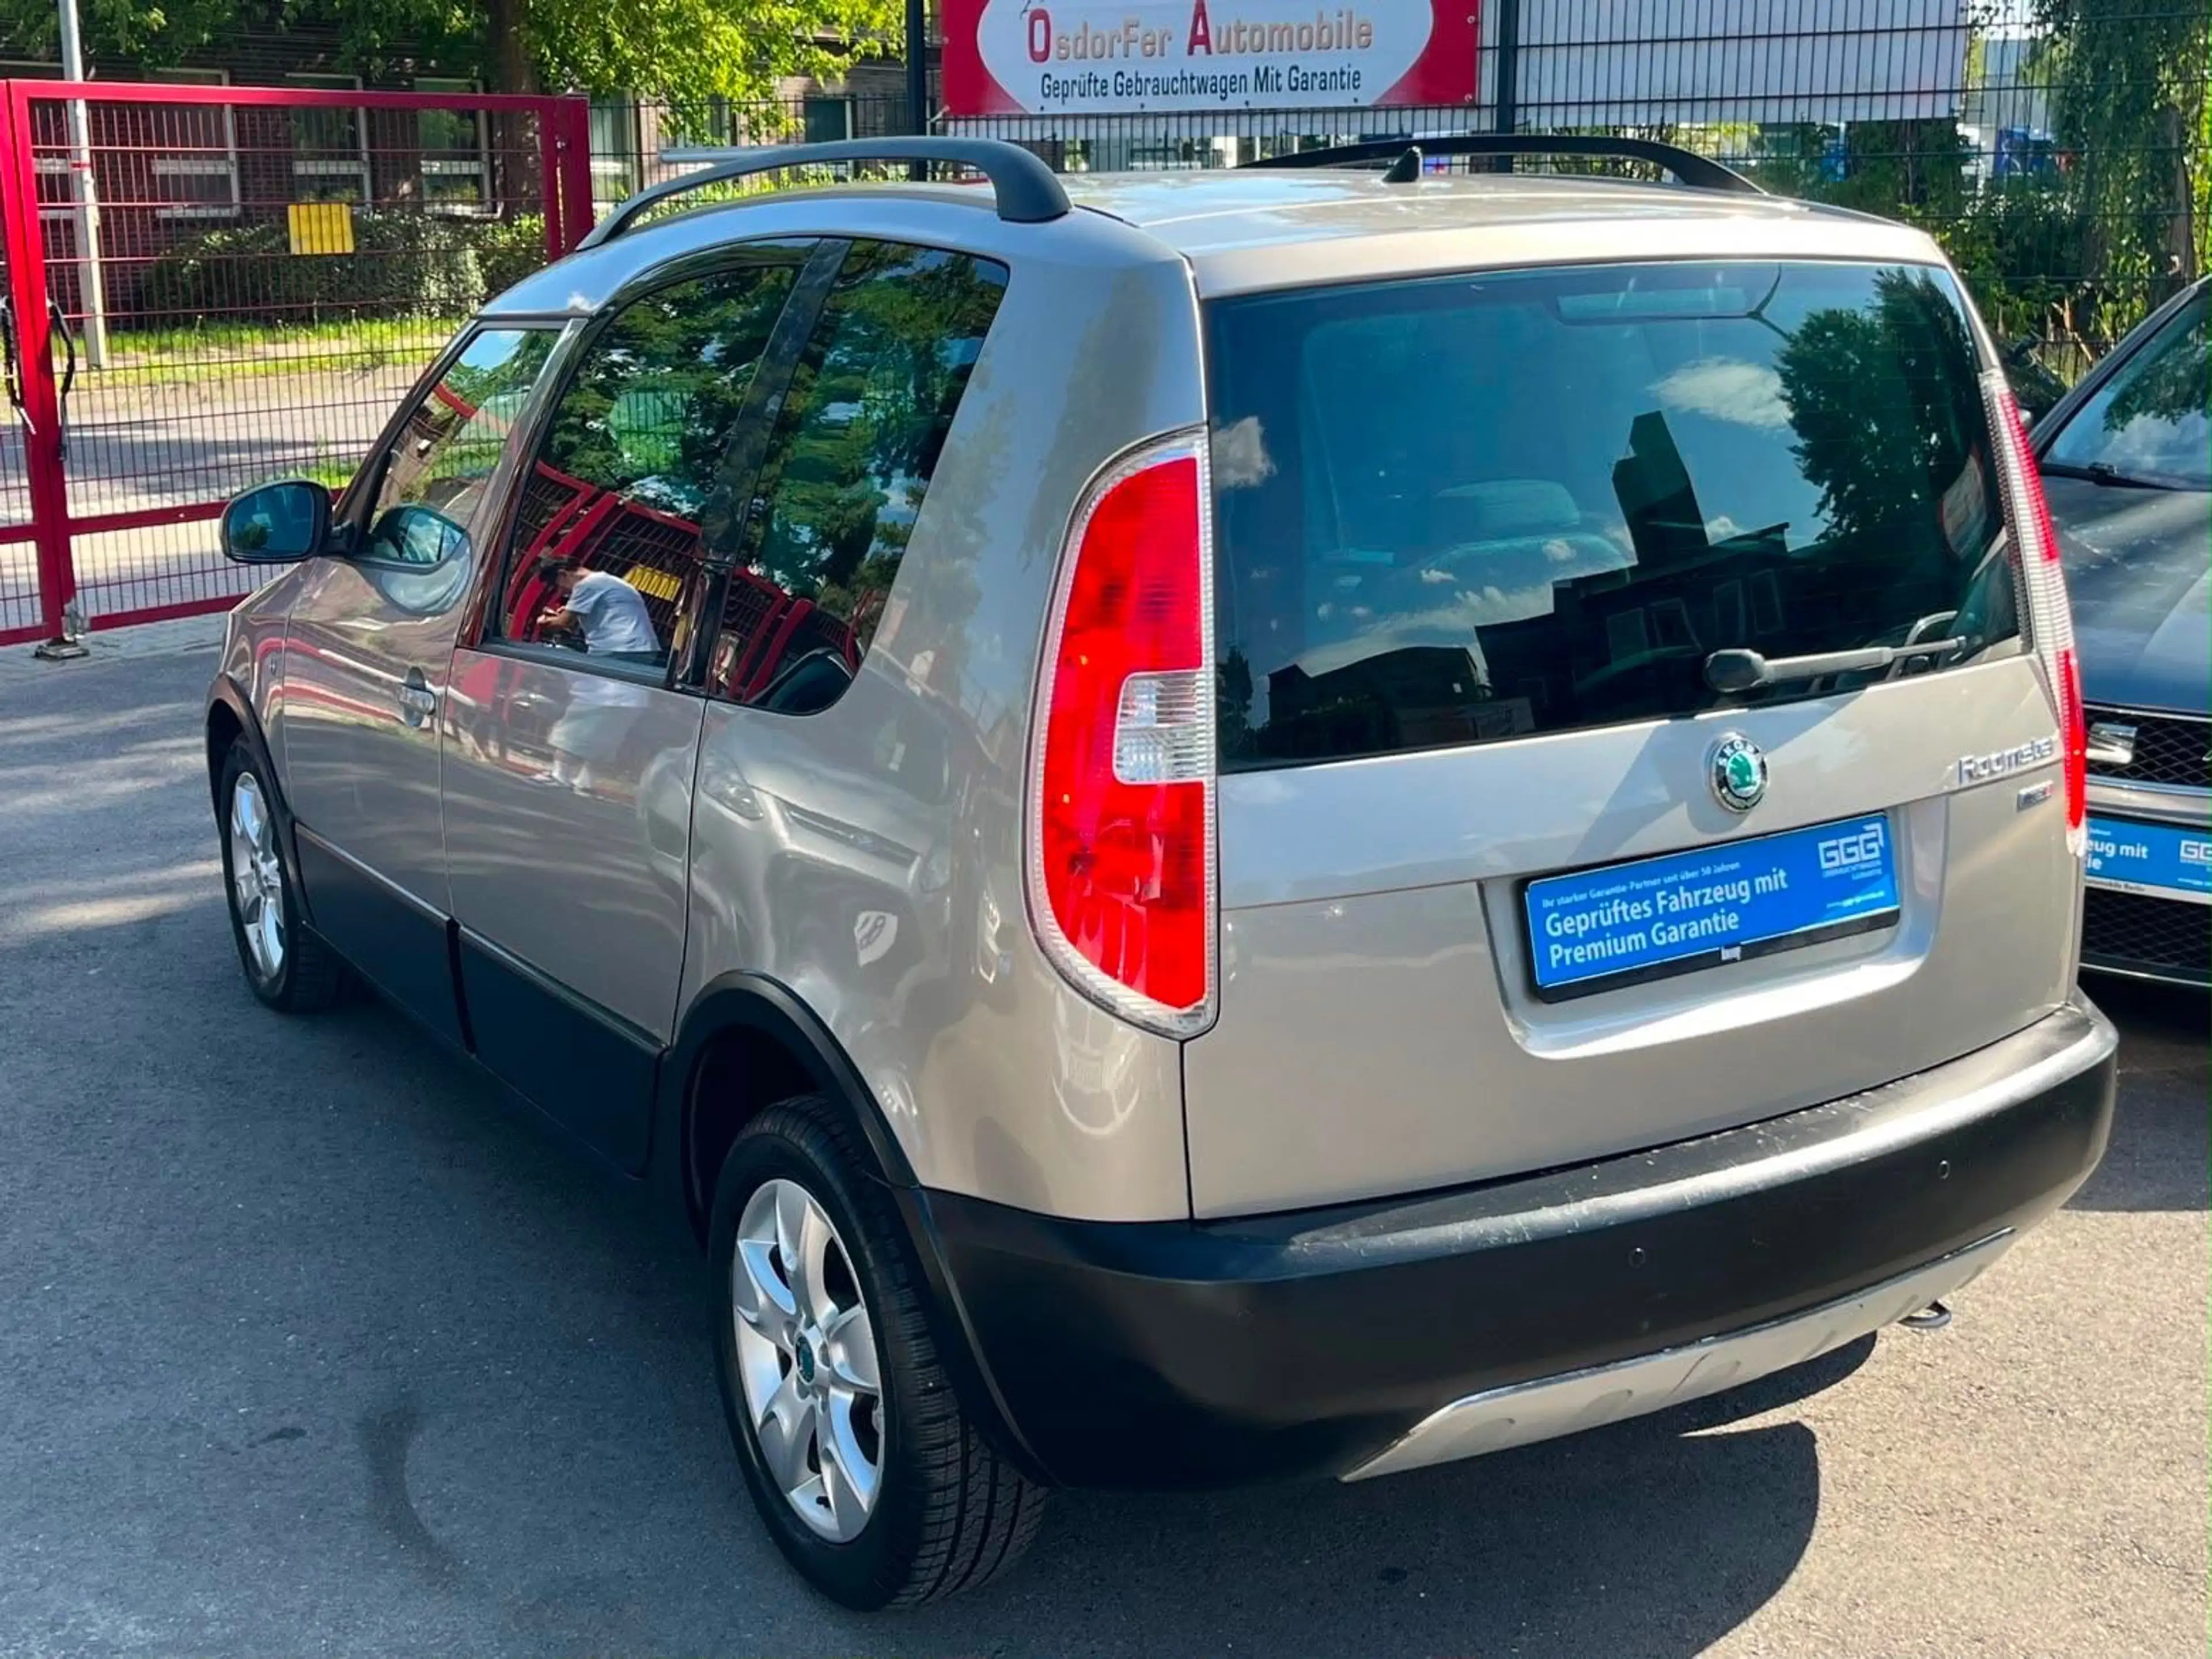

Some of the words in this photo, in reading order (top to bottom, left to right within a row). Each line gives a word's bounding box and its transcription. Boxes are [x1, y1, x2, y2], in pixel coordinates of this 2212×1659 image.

[1187, 0, 1372, 56] Automobile
[1041, 71, 1108, 104] Geprüfte
[1113, 69, 1248, 101] Gebrauchtwagen
[1254, 65, 1282, 93] Mit
[1288, 63, 1361, 92] Garantie
[1818, 831, 1881, 869] GGG
[2119, 842, 2149, 859] mit
[1546, 898, 1653, 938] Geprüftes
[1656, 880, 1751, 915] Fahrzeug
[1755, 868, 1789, 895] mit
[1550, 931, 1647, 968] Premium
[1651, 907, 1740, 945] Garantie
